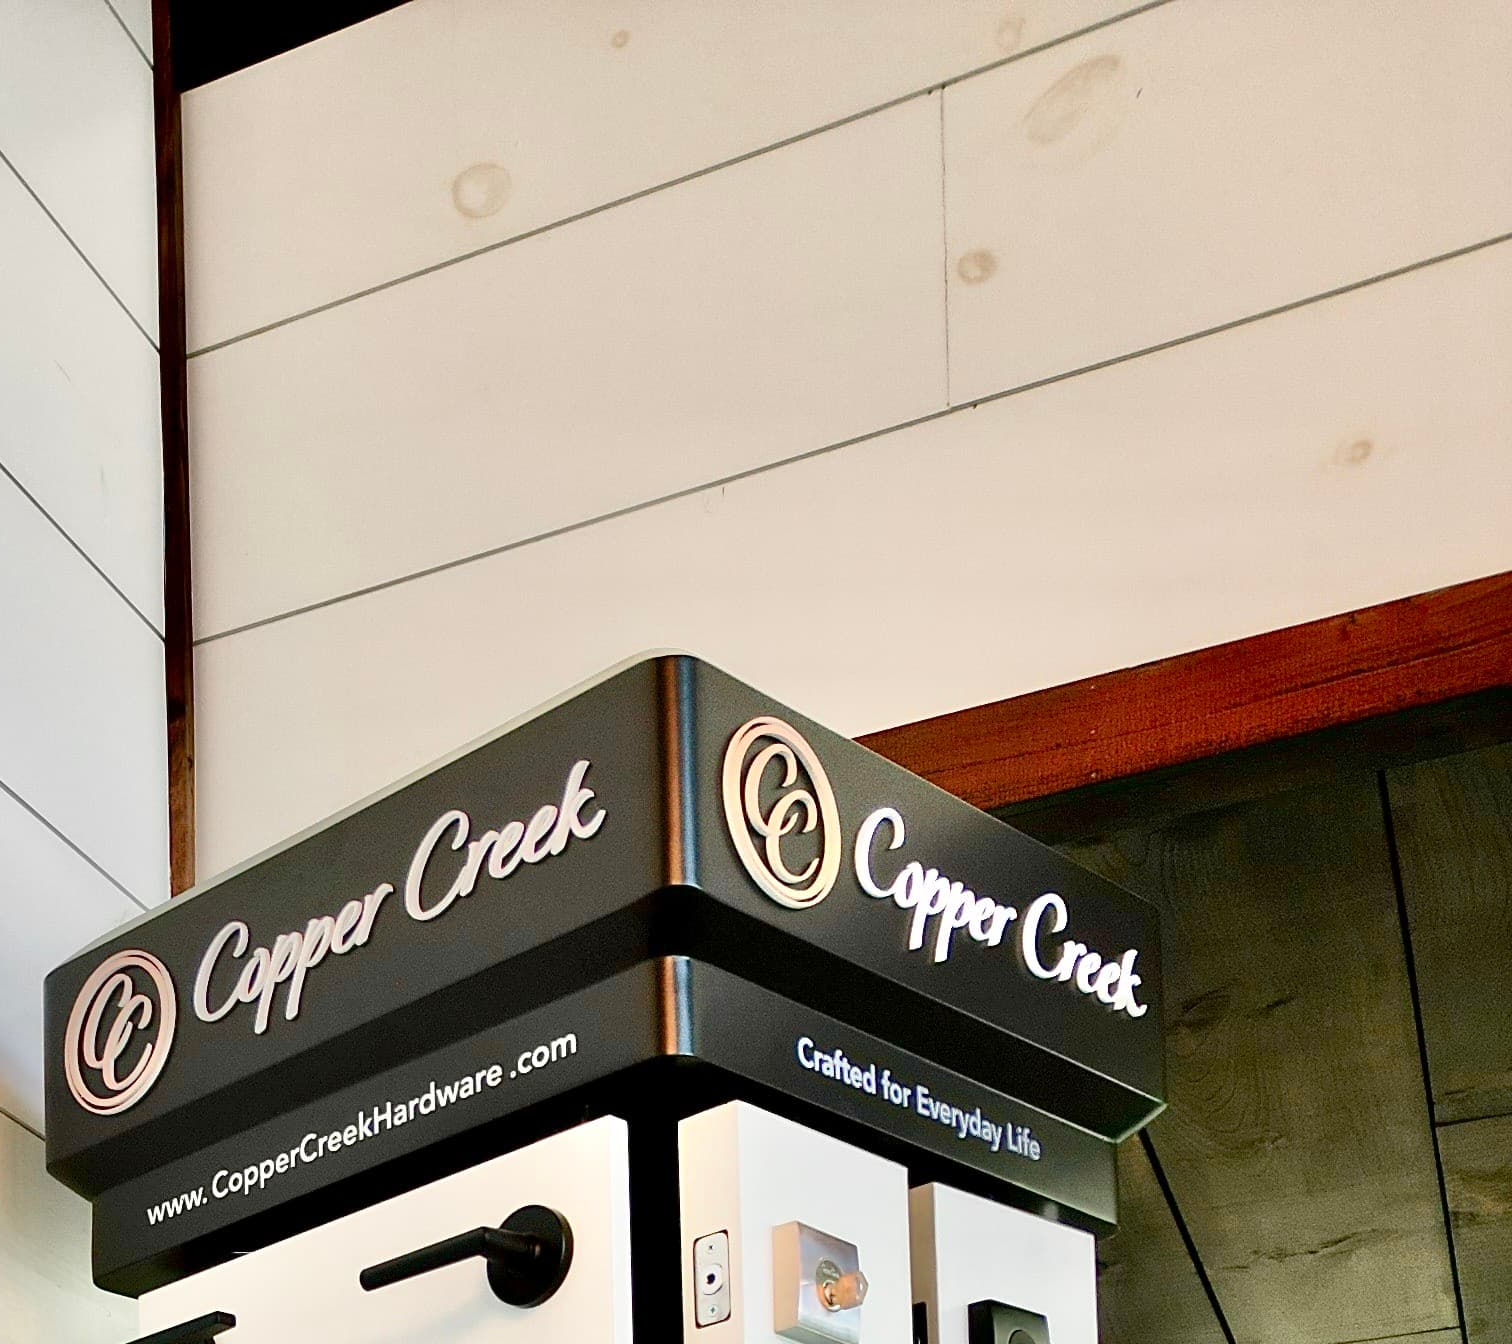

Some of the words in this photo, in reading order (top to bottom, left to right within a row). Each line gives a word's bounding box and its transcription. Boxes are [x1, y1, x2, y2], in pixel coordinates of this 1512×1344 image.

[193, 882, 394, 1034] Copper
[405, 760, 606, 921] Creek
[853, 806, 1018, 963] Copper
[1021, 892, 1148, 1017] Creek
[796, 1036, 877, 1095] Crafted
[881, 1068, 912, 1108] for
[915, 1085, 1003, 1152] Everyday
[1006, 1122, 1041, 1161] Life
